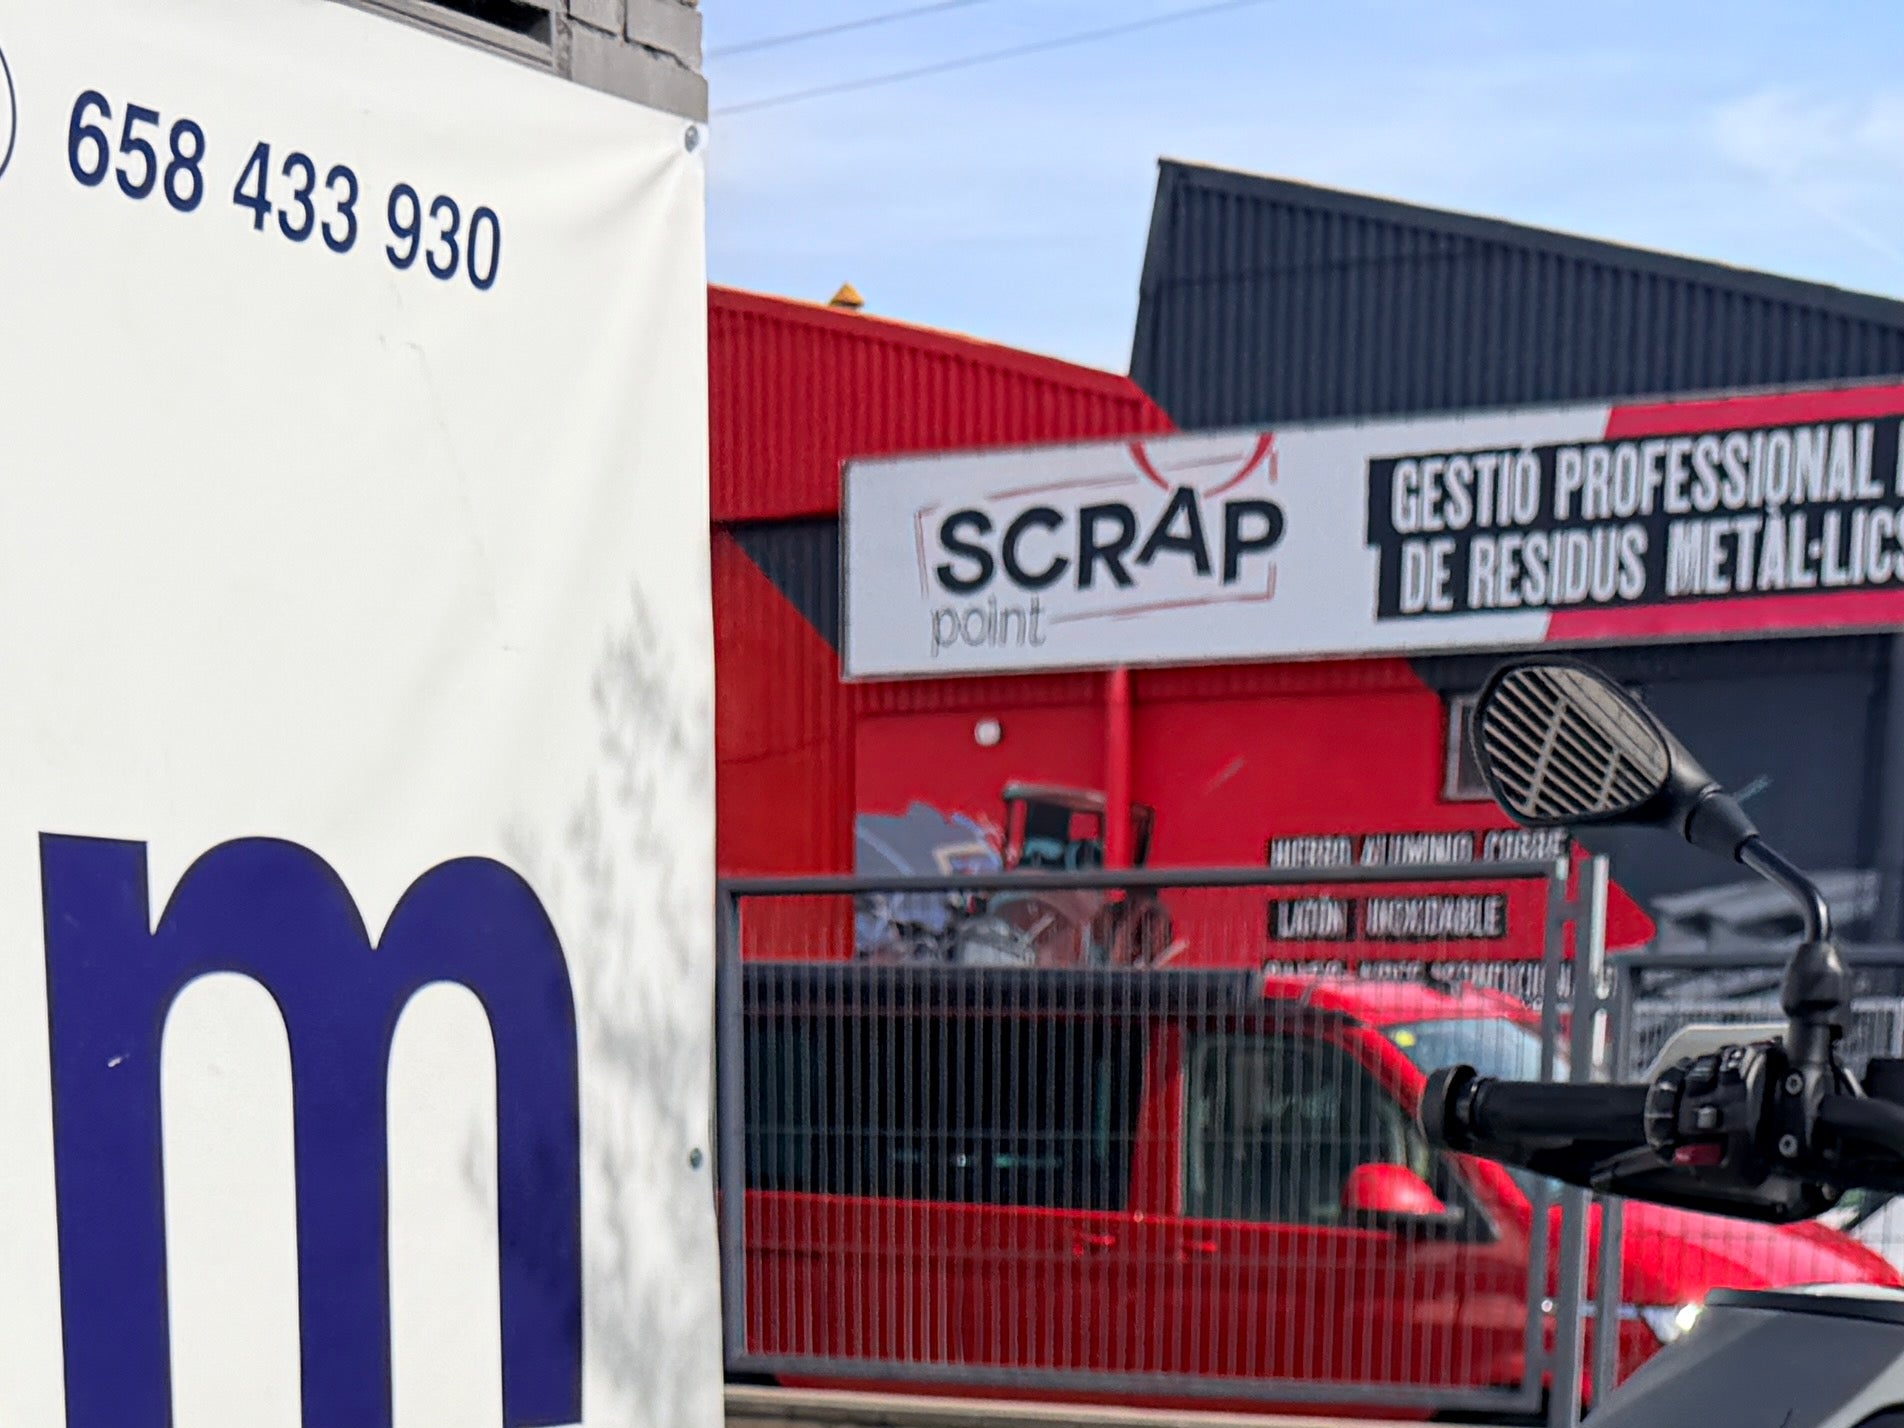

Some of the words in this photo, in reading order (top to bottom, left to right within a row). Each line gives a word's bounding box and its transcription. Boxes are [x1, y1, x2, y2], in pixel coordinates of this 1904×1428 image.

[68, 90, 205, 212] 658
[233, 141, 359, 254] 433
[386, 183, 500, 291] 930
[1391, 447, 1541, 534] GESTIÓ
[1554, 421, 1884, 520] PROFESSIONAL
[936, 485, 1284, 593] SCRAP
[1400, 537, 1456, 614] DE
[1467, 523, 1648, 609] RESIDUS
[930, 593, 1046, 657] point
